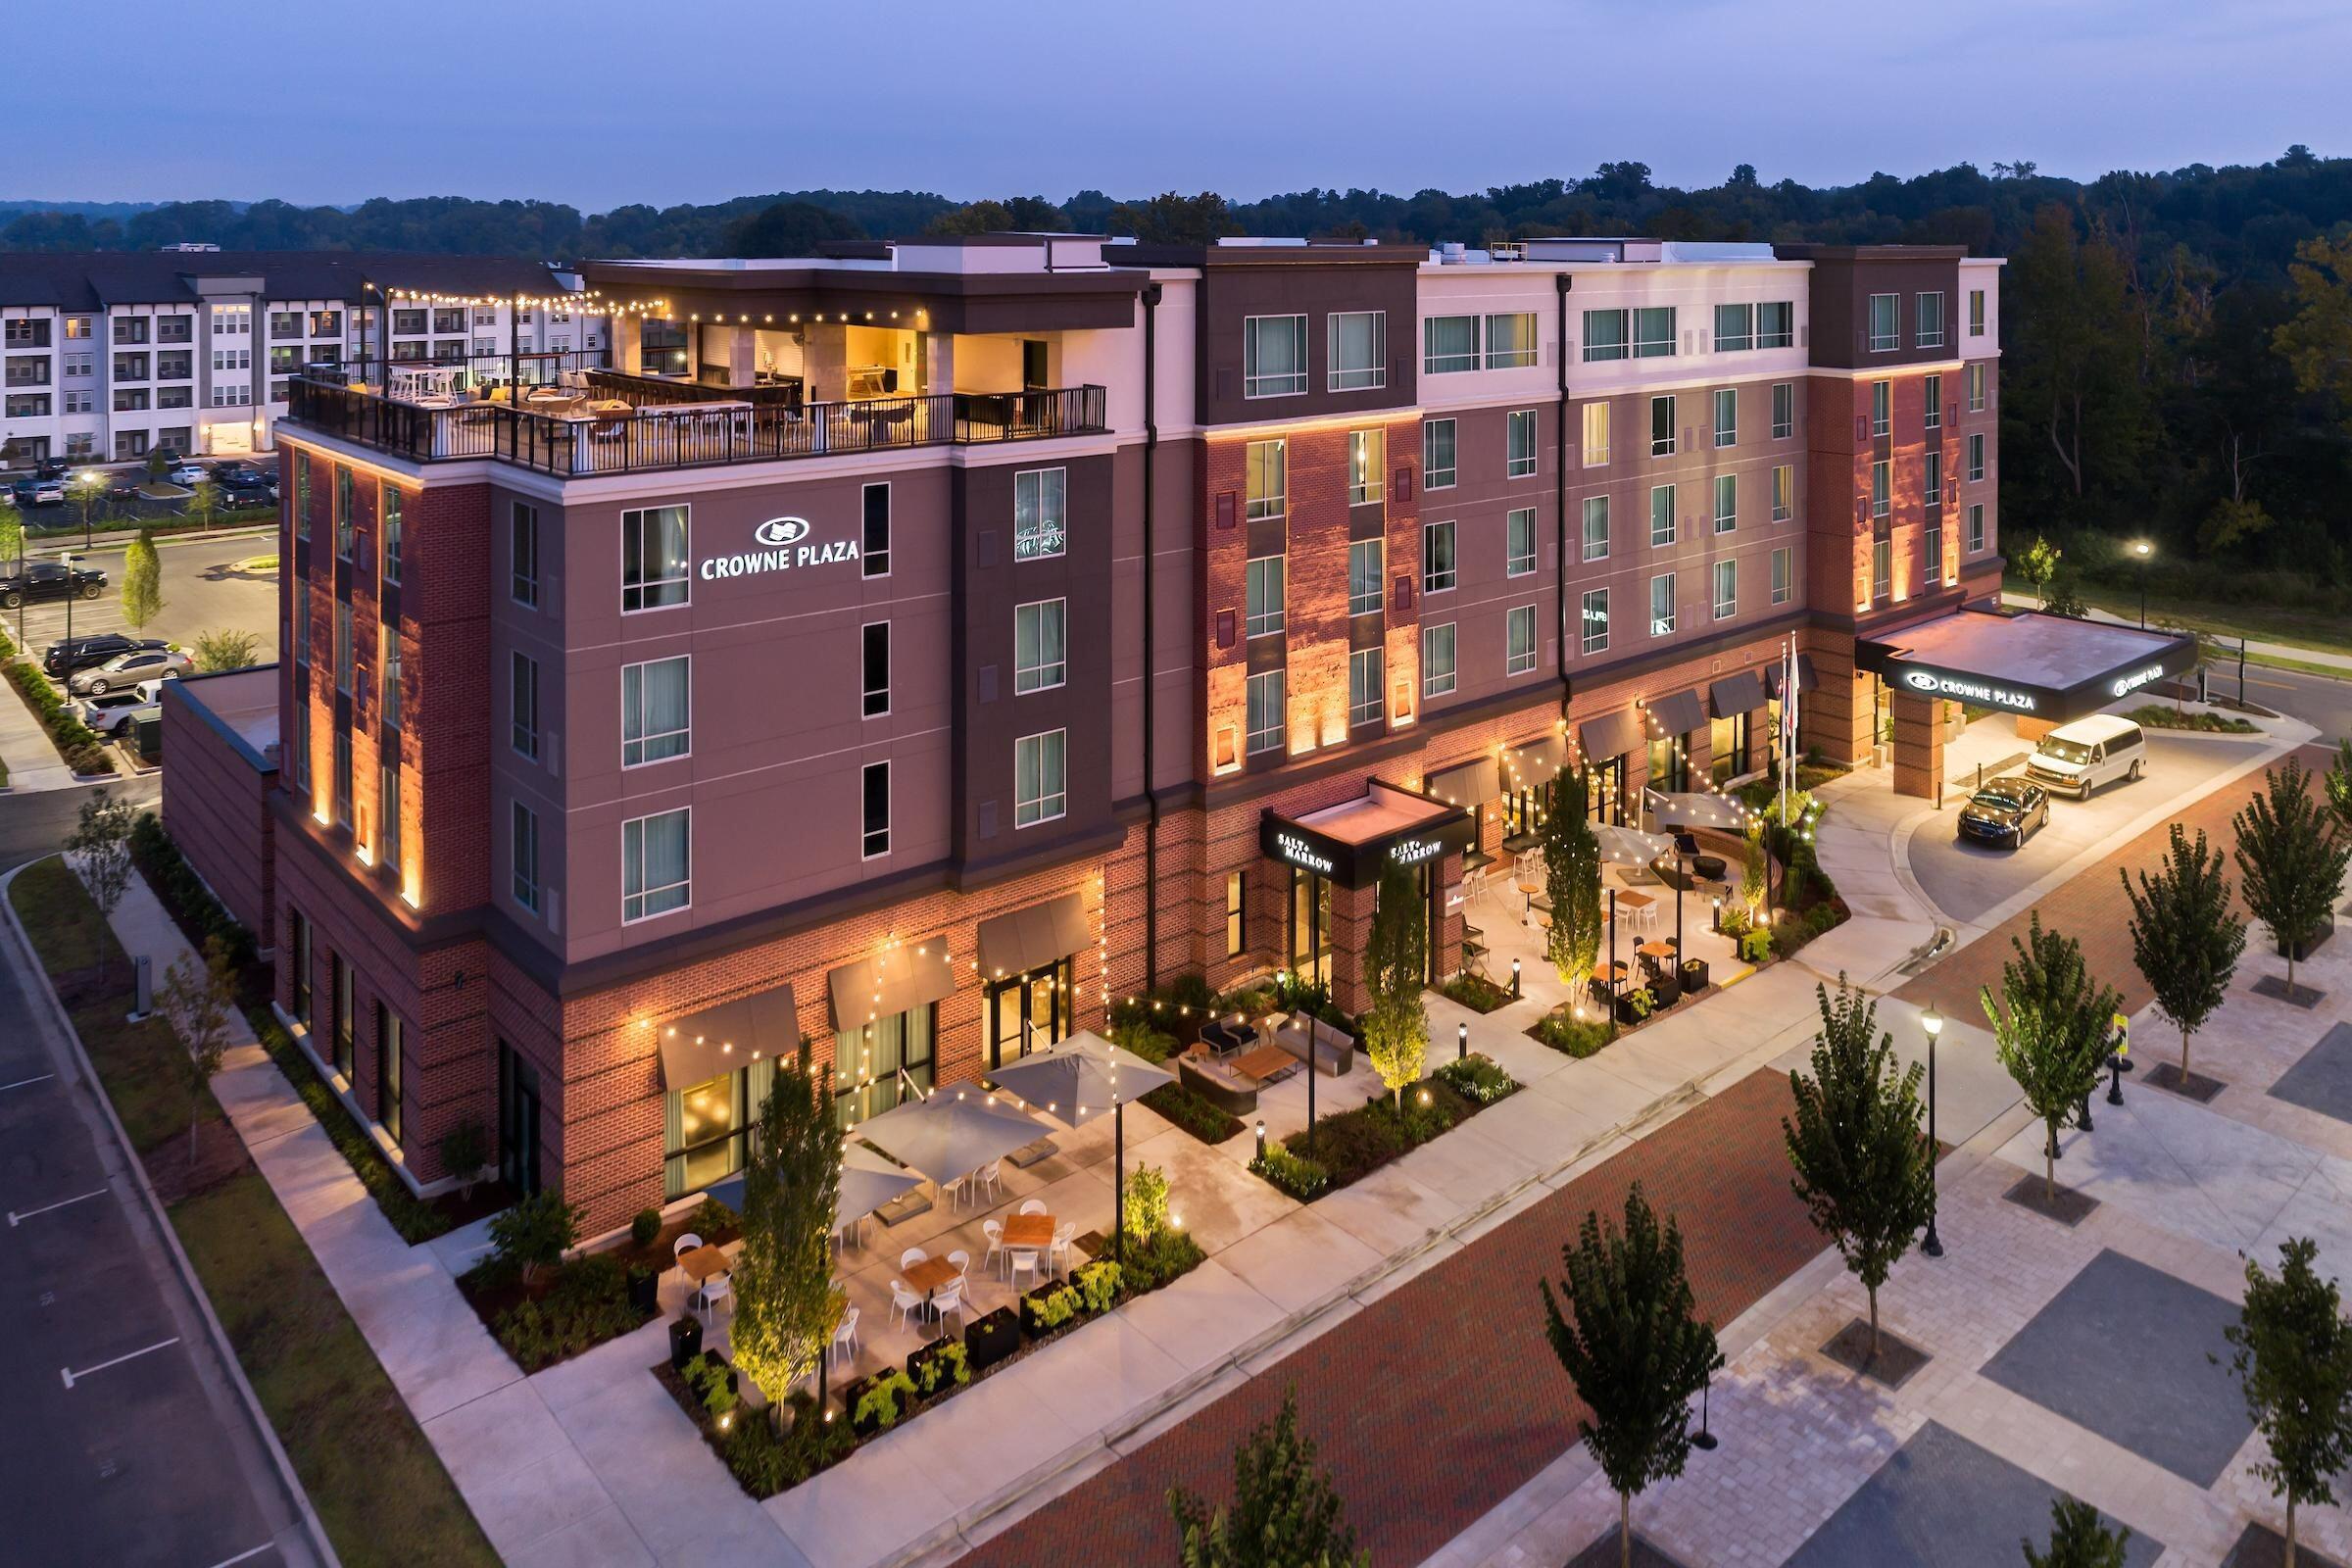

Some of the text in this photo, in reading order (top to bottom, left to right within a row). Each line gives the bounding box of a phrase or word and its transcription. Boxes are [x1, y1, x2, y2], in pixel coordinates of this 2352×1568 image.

[701, 541, 859, 580] CROWNE PLAZA
[1940, 680, 2034, 710] CROWNE PLAZA
[1285, 845, 1333, 873] MARROW
